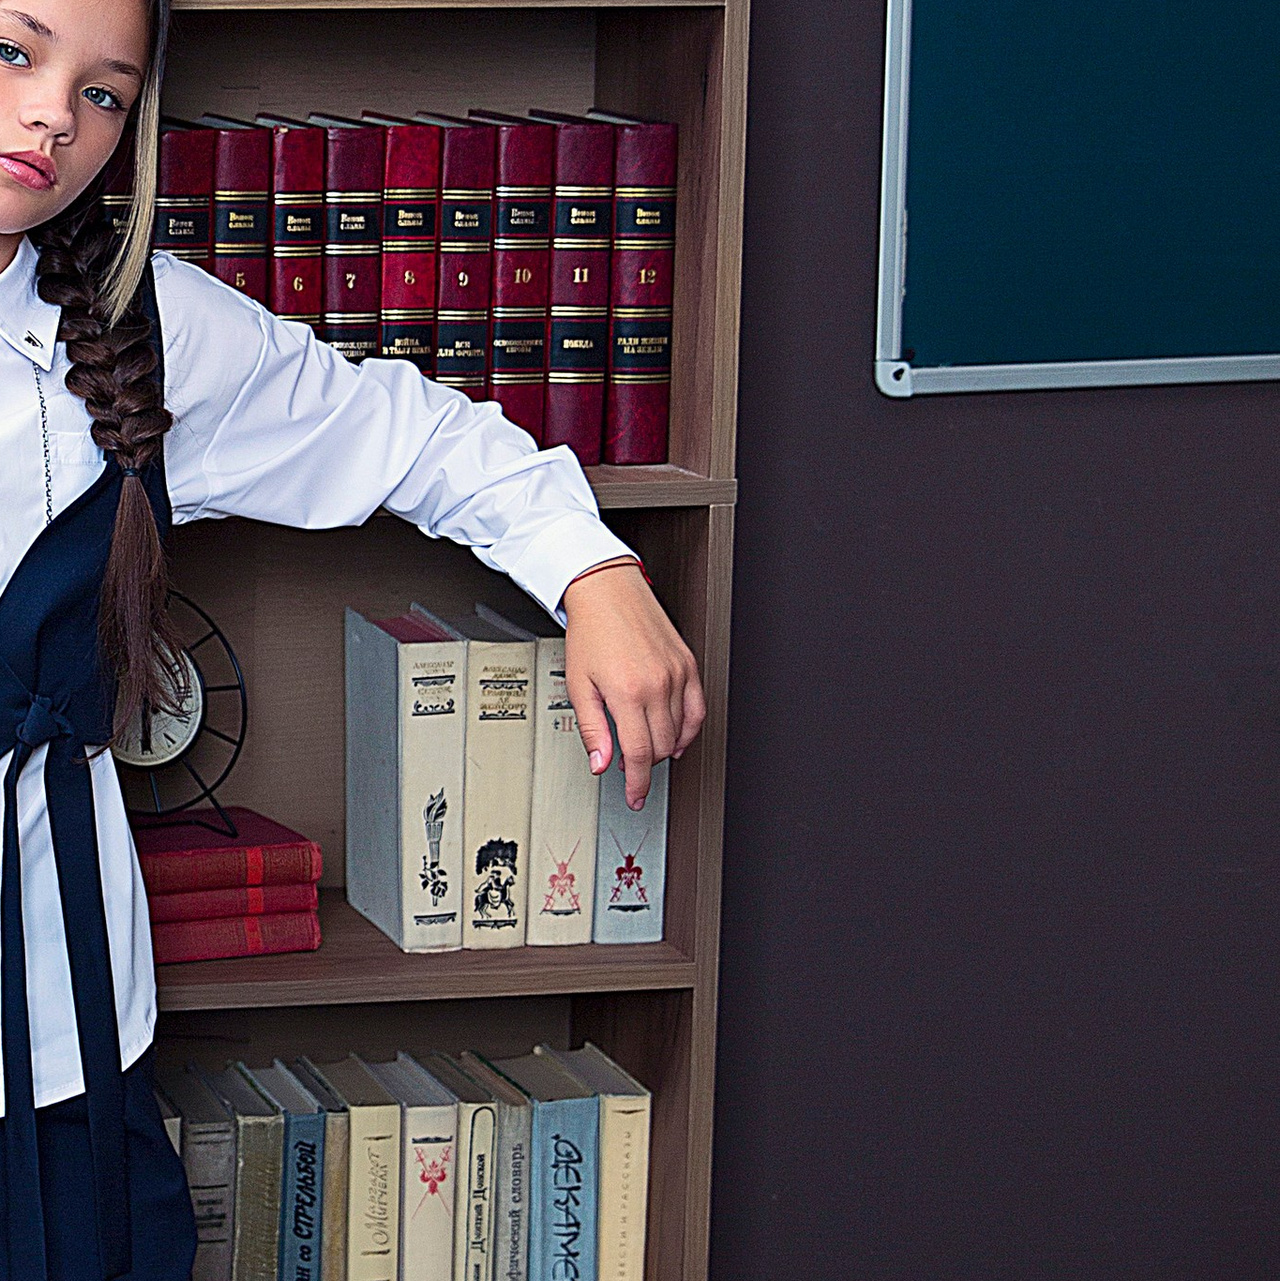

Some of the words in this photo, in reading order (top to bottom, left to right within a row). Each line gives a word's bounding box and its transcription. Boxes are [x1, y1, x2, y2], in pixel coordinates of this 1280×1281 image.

[235, 272, 246, 288] 5
[345, 272, 356, 289] 7
[404, 270, 416, 285] 8
[458, 271, 469, 287] 9
[514, 268, 532, 284] 10
[573, 267, 589, 283] 11
[638, 268, 657, 284] 12
[293, 276, 304, 291] 6
[510, 1142, 524, 1203] словарь
[292, 1140, 317, 1240] СТРЕЛЬБОЙ
[299, 1244, 313, 1262] со
